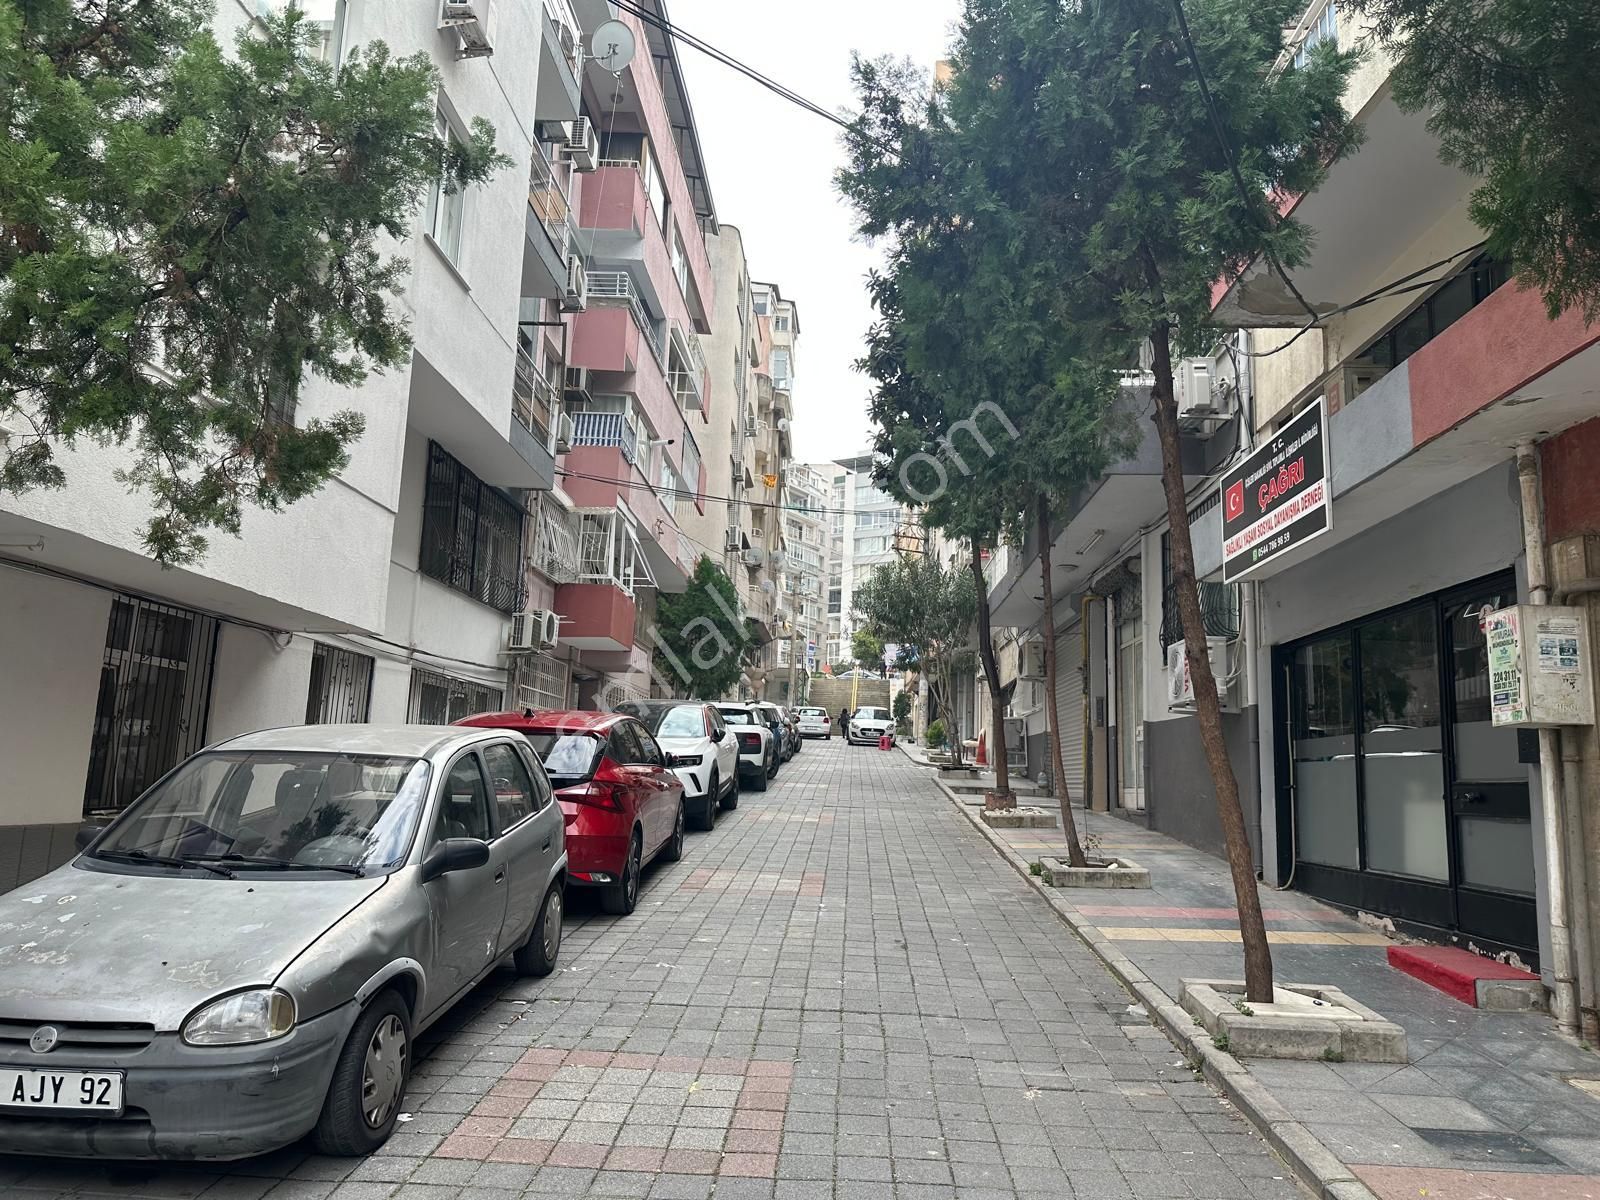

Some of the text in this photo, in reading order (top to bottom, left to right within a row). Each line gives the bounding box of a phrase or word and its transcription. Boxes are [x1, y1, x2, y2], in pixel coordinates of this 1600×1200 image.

[1258, 455, 1305, 513] ÇAĞRI
[1226, 482, 1325, 557] SAĞLIKLI YAŞAM SOSYAL DAYANIŞMA DERNEĞİ
[1257, 543, 1269, 557] 0544
[1493, 669, 1517, 683] 224 31 11
[12, 1074, 111, 1105] AJY 92
